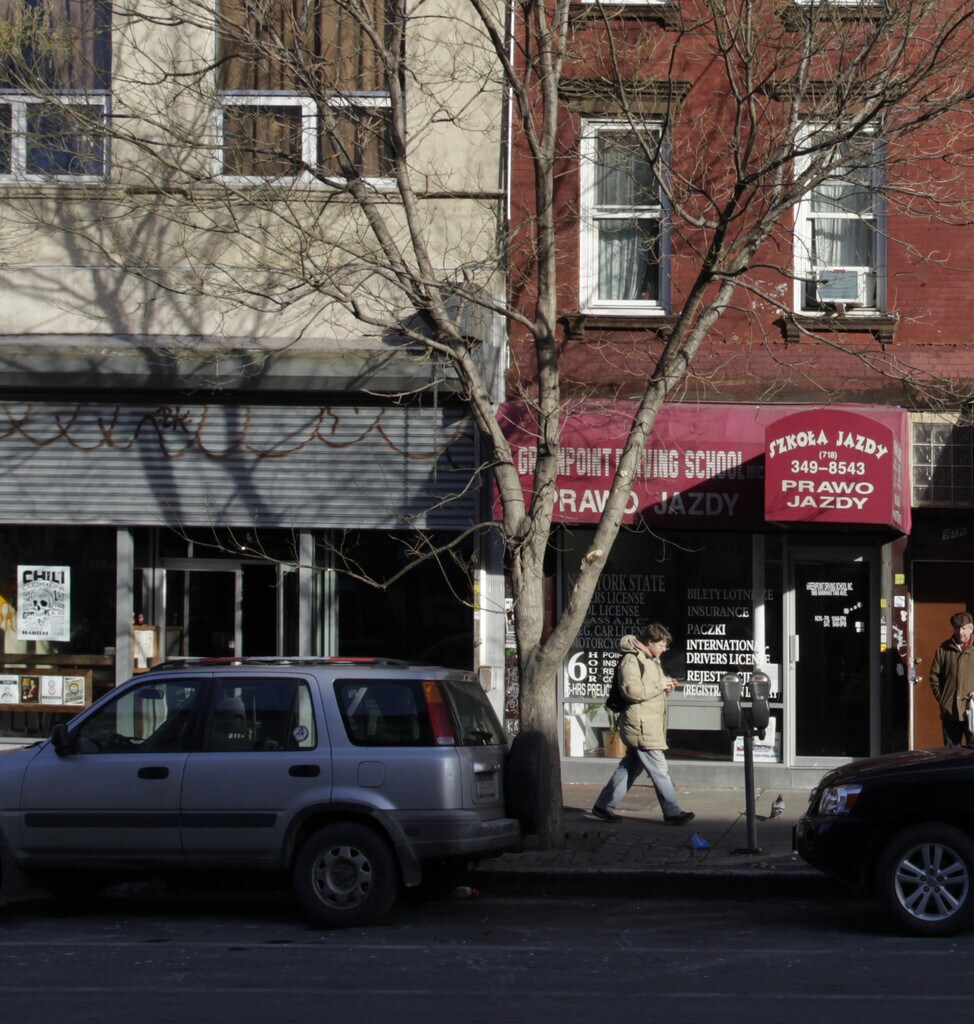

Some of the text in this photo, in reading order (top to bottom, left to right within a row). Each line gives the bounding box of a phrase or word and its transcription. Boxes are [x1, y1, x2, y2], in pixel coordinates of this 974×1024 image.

[769, 429, 889, 460] SZKOŁA JAZDY
[818, 451, 838, 460] (718)
[517, 446, 613, 477] GRNPOINT
[684, 450, 744, 480] SCHOOL
[790, 460, 866, 475] 349-8543
[781, 480, 874, 494] PRAWO
[653, 491, 740, 518] JAZDY
[787, 496, 869, 510] JAZDY
[23, 570, 65, 585] CHILI
[629, 574, 666, 593] STATE
[608, 592, 646, 605] LICENSE
[687, 588, 721, 601] BILETY
[599, 605, 640, 617] LICENSE
[687, 606, 750, 618] INSURANCE
[594, 625, 615, 637] CAR
[687, 624, 727, 636] PACZKI
[686, 652, 771, 666] DRIVERS LICENE
[567, 651, 588, 682] 6
